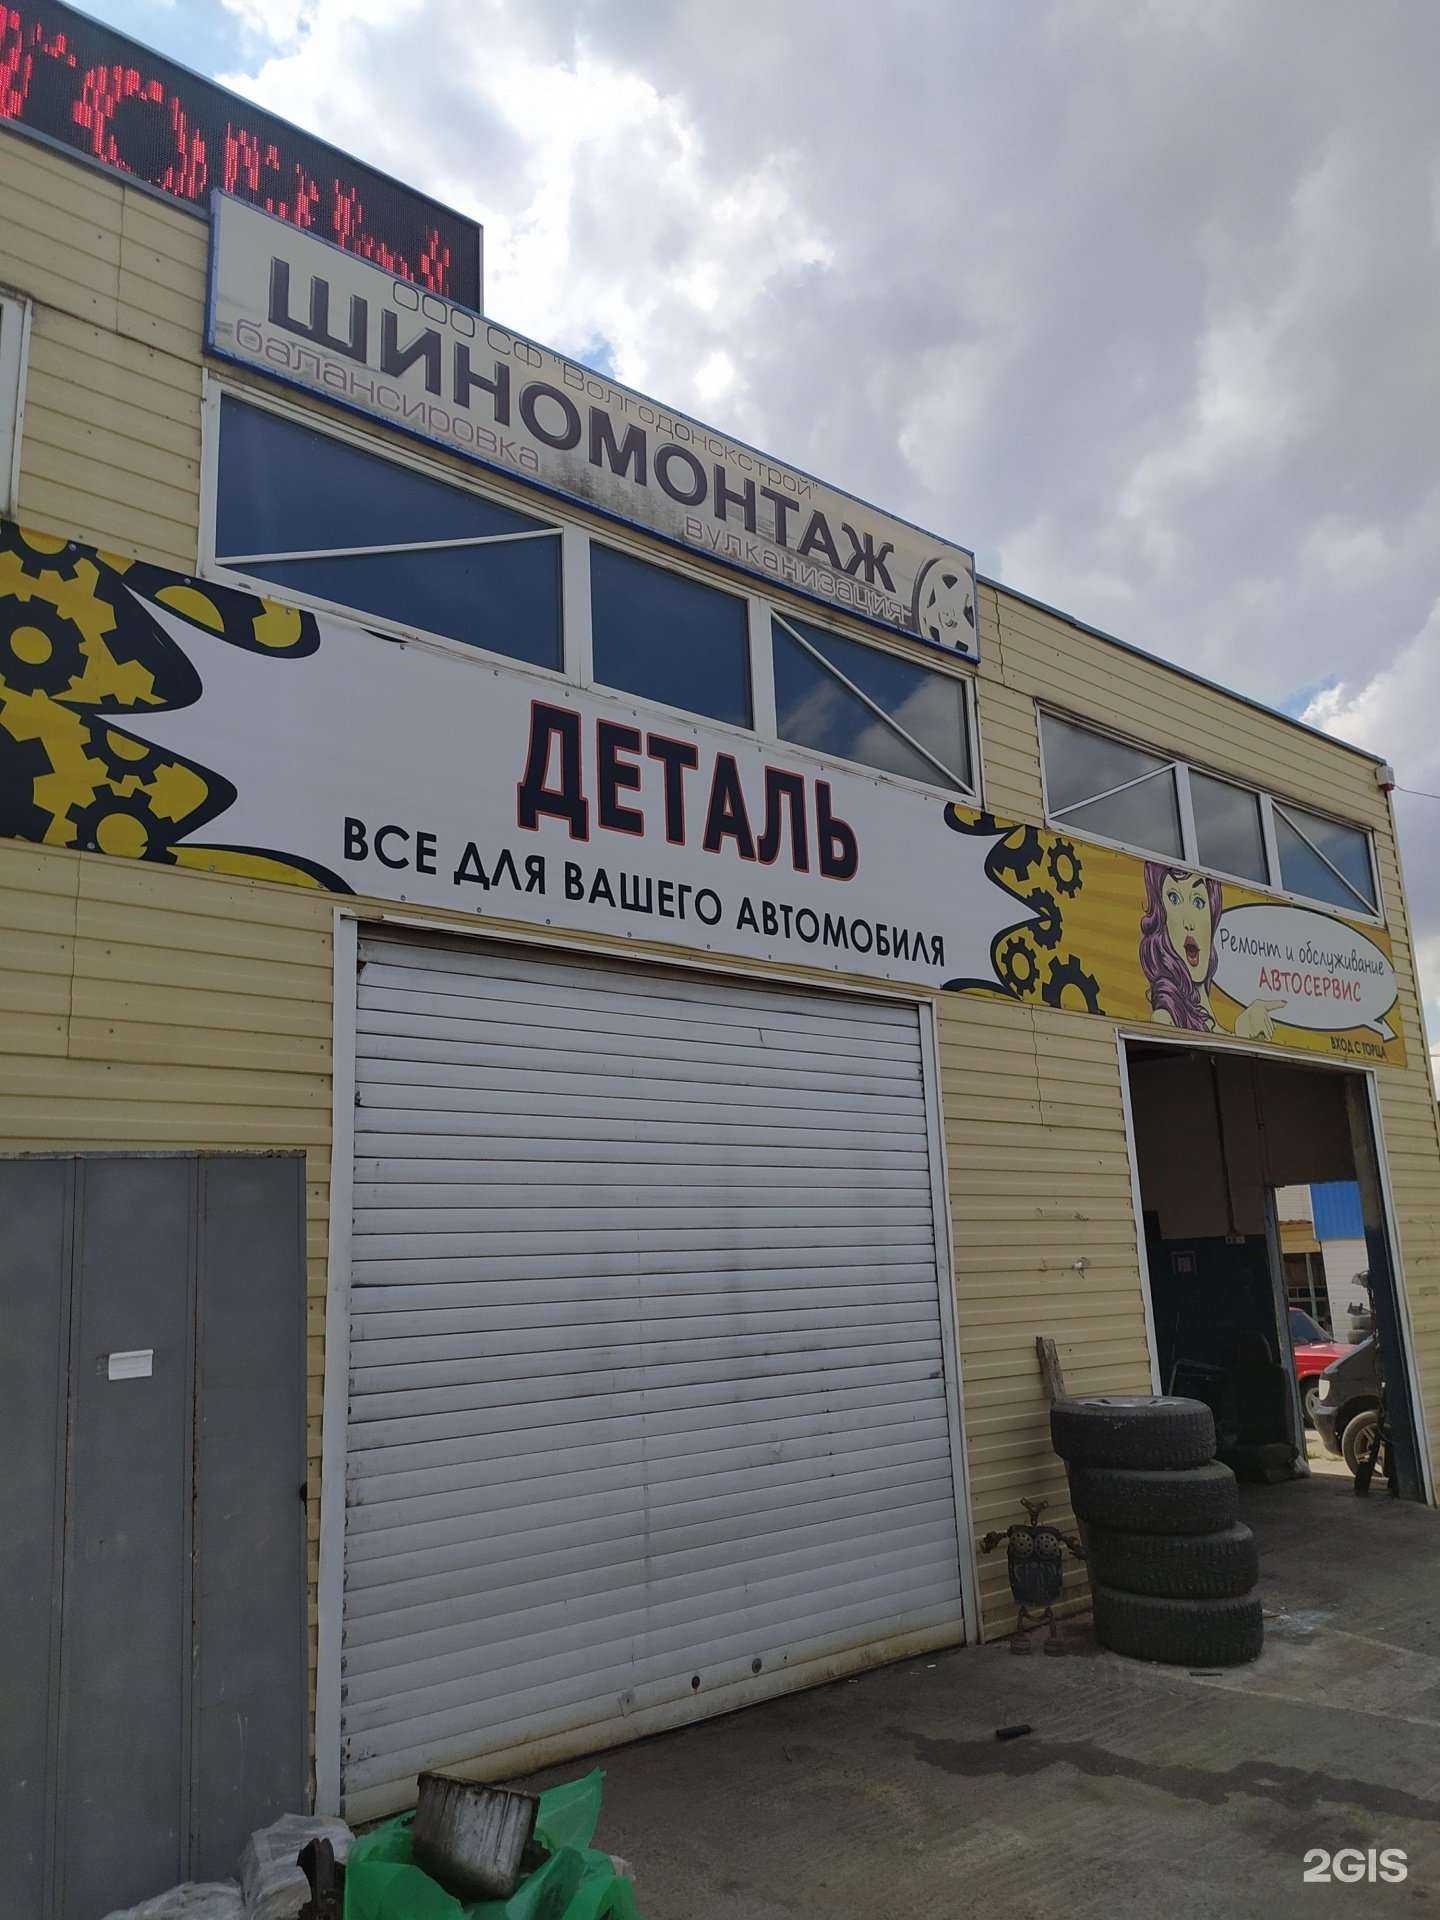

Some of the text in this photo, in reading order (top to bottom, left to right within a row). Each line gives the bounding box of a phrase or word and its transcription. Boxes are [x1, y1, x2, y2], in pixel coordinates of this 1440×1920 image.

[393, 281, 475, 338] ООО
[486, 326, 543, 369] СФ
[236, 319, 540, 472] балансировка
[268, 256, 897, 594] ШИНОМОНТАЖ
[685, 516, 905, 625] вулканизация
[517, 699, 859, 881] ДЕТАЛЬ
[343, 816, 946, 968] ВСЕ ДЛЯ ВАШЕГО АВТОМОБИЛЯ
[1220, 928, 1384, 976] Ремонт и обслуживание
[1258, 967, 1361, 1002] АВТОСЕРВИС
